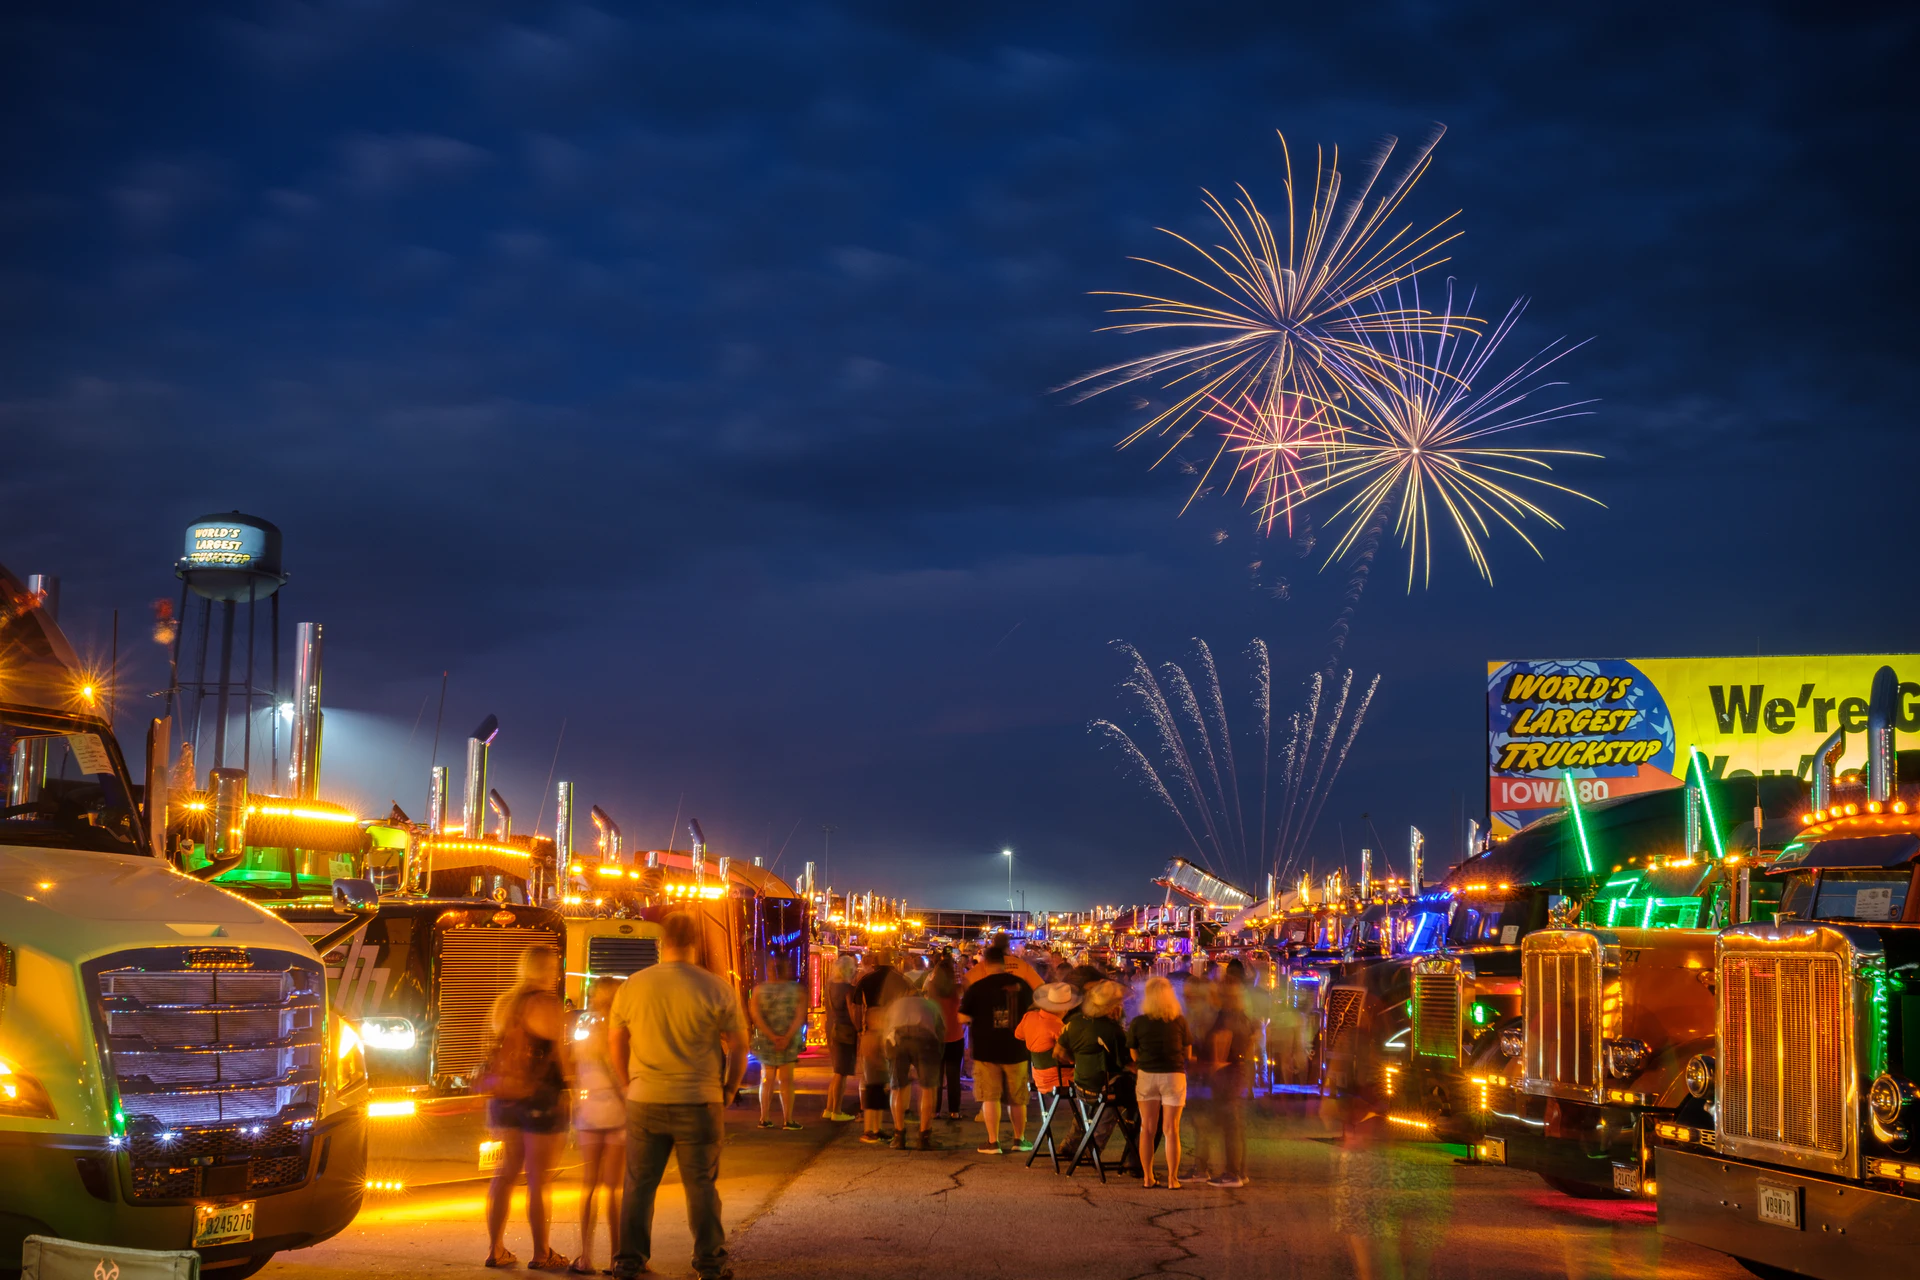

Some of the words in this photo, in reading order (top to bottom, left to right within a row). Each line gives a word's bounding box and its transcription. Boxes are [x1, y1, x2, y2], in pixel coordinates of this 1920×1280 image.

[194, 528, 241, 539] WORLD'S
[195, 540, 242, 551] LARGEST
[1503, 673, 1633, 704] WORLD'S
[1708, 683, 1869, 734] We're
[1510, 708, 1638, 737] LARGEST
[1496, 739, 1663, 773] TRUCKSTOP
[1502, 782, 1570, 803] IOWA
[1578, 780, 1609, 803] 80
[1625, 950, 1641, 962] 27
